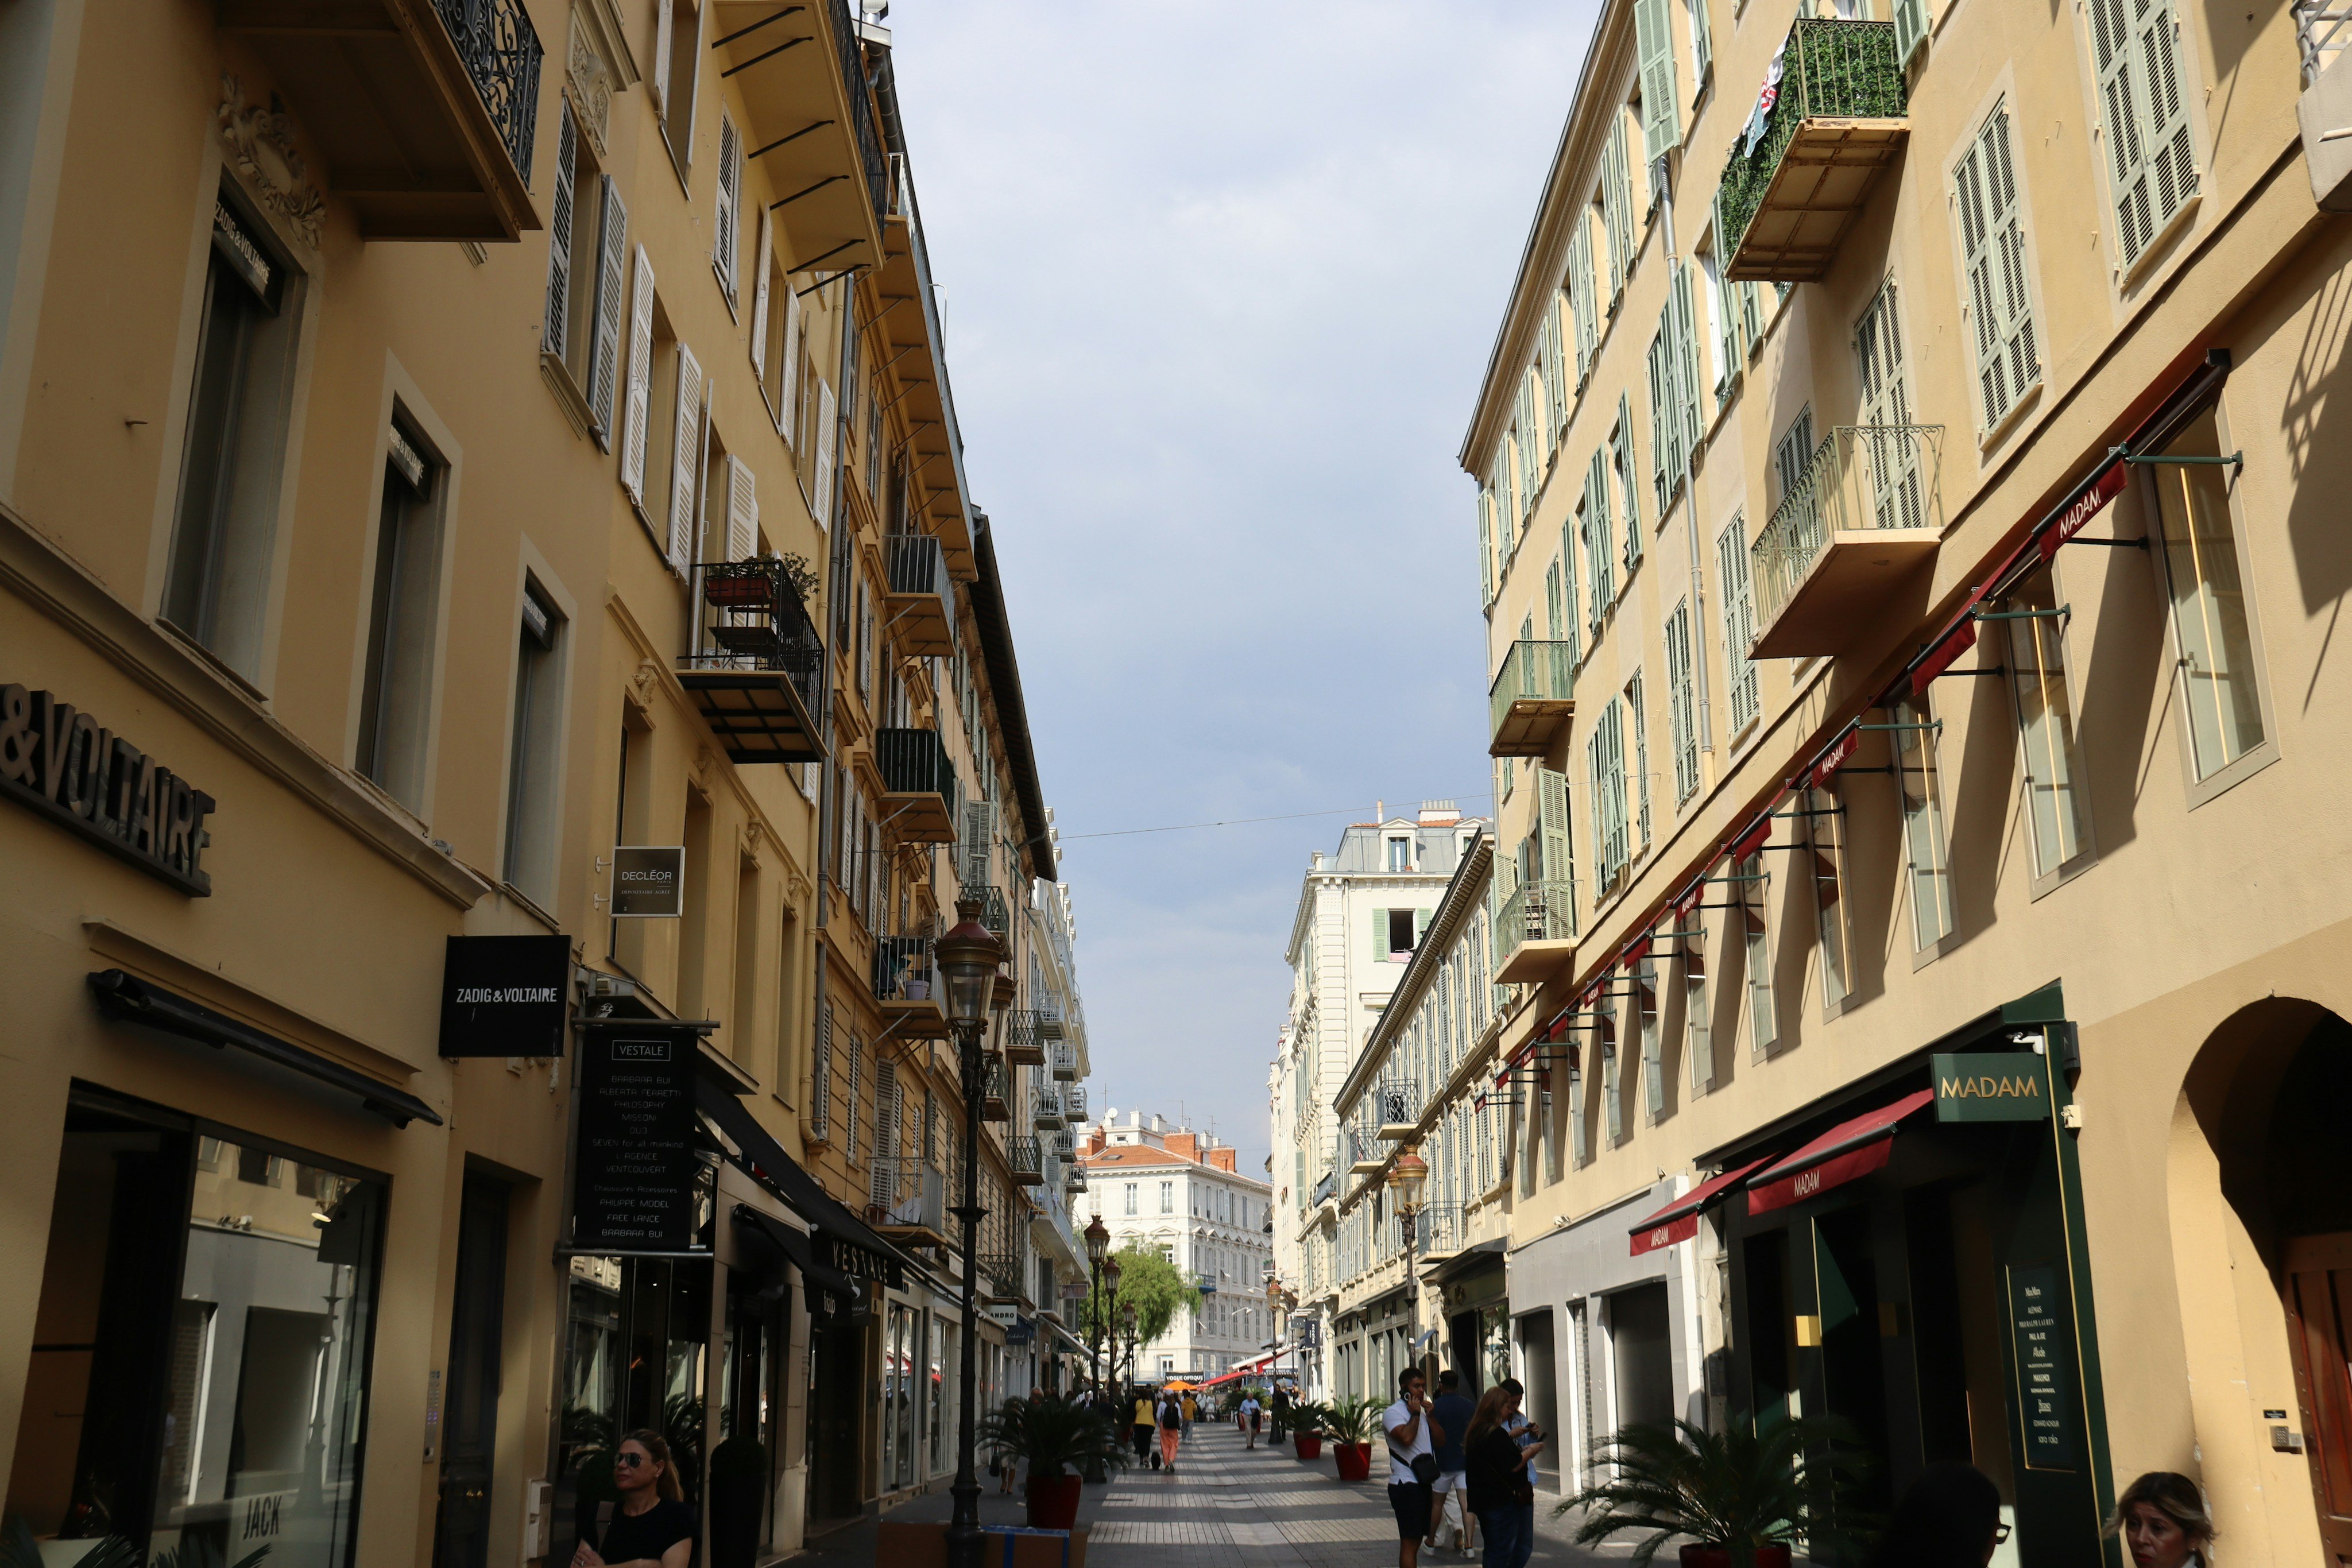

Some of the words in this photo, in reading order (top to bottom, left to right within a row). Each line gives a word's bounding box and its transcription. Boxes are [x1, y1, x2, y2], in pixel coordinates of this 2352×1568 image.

[2059, 486, 2102, 539] MADAM
[1821, 742, 1845, 775] MADAM
[622, 869, 672, 880] DECLÉOR
[1681, 890, 1697, 914] MADAM
[618, 1044, 664, 1056] VESTALE
[656, 1076, 671, 1085] BUI
[599, 1088, 637, 1096] ALBERTA
[1941, 1075, 2038, 1099] MADAM
[614, 1101, 667, 1109] PHILOSOPHY
[621, 1113, 657, 1121] MISSONI
[592, 1139, 618, 1147] SEVEN
[622, 1139, 634, 1147] for
[594, 1184, 635, 1193] Chaussures
[637, 1186, 678, 1194] Accessoires
[1794, 1170, 1820, 1198] MADAM
[599, 1198, 636, 1207] PHILIPPE
[639, 1199, 670, 1208] MODEL
[606, 1214, 629, 1222] FREE
[633, 1214, 660, 1223] LANCE
[1650, 1226, 1670, 1247] MADAM
[833, 1240, 888, 1284] VESTALE
[243, 1495, 281, 1541] JACK
